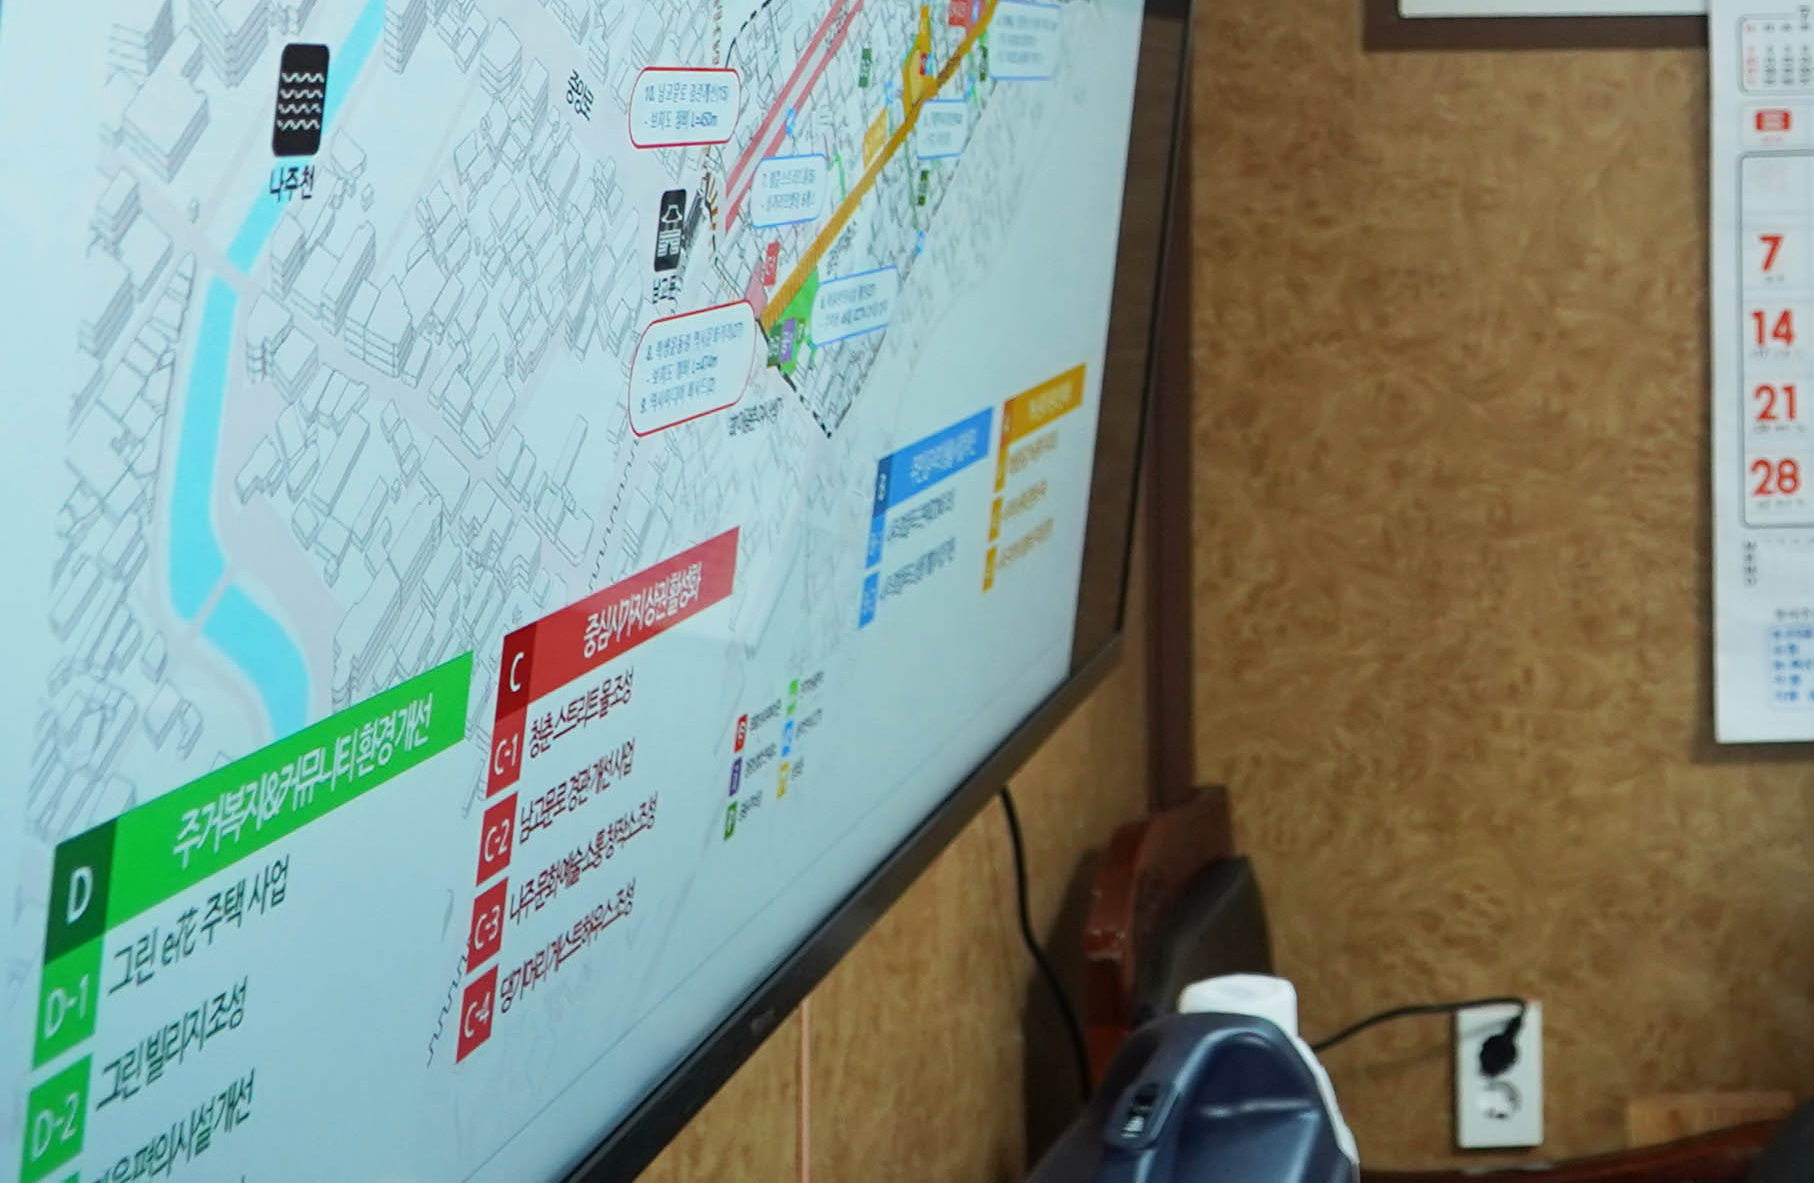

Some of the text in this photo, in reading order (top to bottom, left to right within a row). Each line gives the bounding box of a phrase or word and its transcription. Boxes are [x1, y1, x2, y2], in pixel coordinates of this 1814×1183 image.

[269, 165, 315, 202] 나주천
[1758, 234, 1784, 272] 7
[1750, 309, 1796, 346] 14
[1753, 384, 1797, 421] 21
[1750, 458, 1801, 496] 28
[508, 652, 525, 692] C
[493, 733, 520, 775] C-1
[484, 818, 510, 862] C-2
[66, 865, 94, 926] D
[44, 973, 89, 1040] D-1
[107, 926, 158, 998] 그린
[201, 877, 247, 947] 주택
[248, 853, 291, 916] 사업
[473, 905, 500, 950] C-3
[464, 992, 490, 1038] C-4
[31, 1091, 80, 1162] D-2
